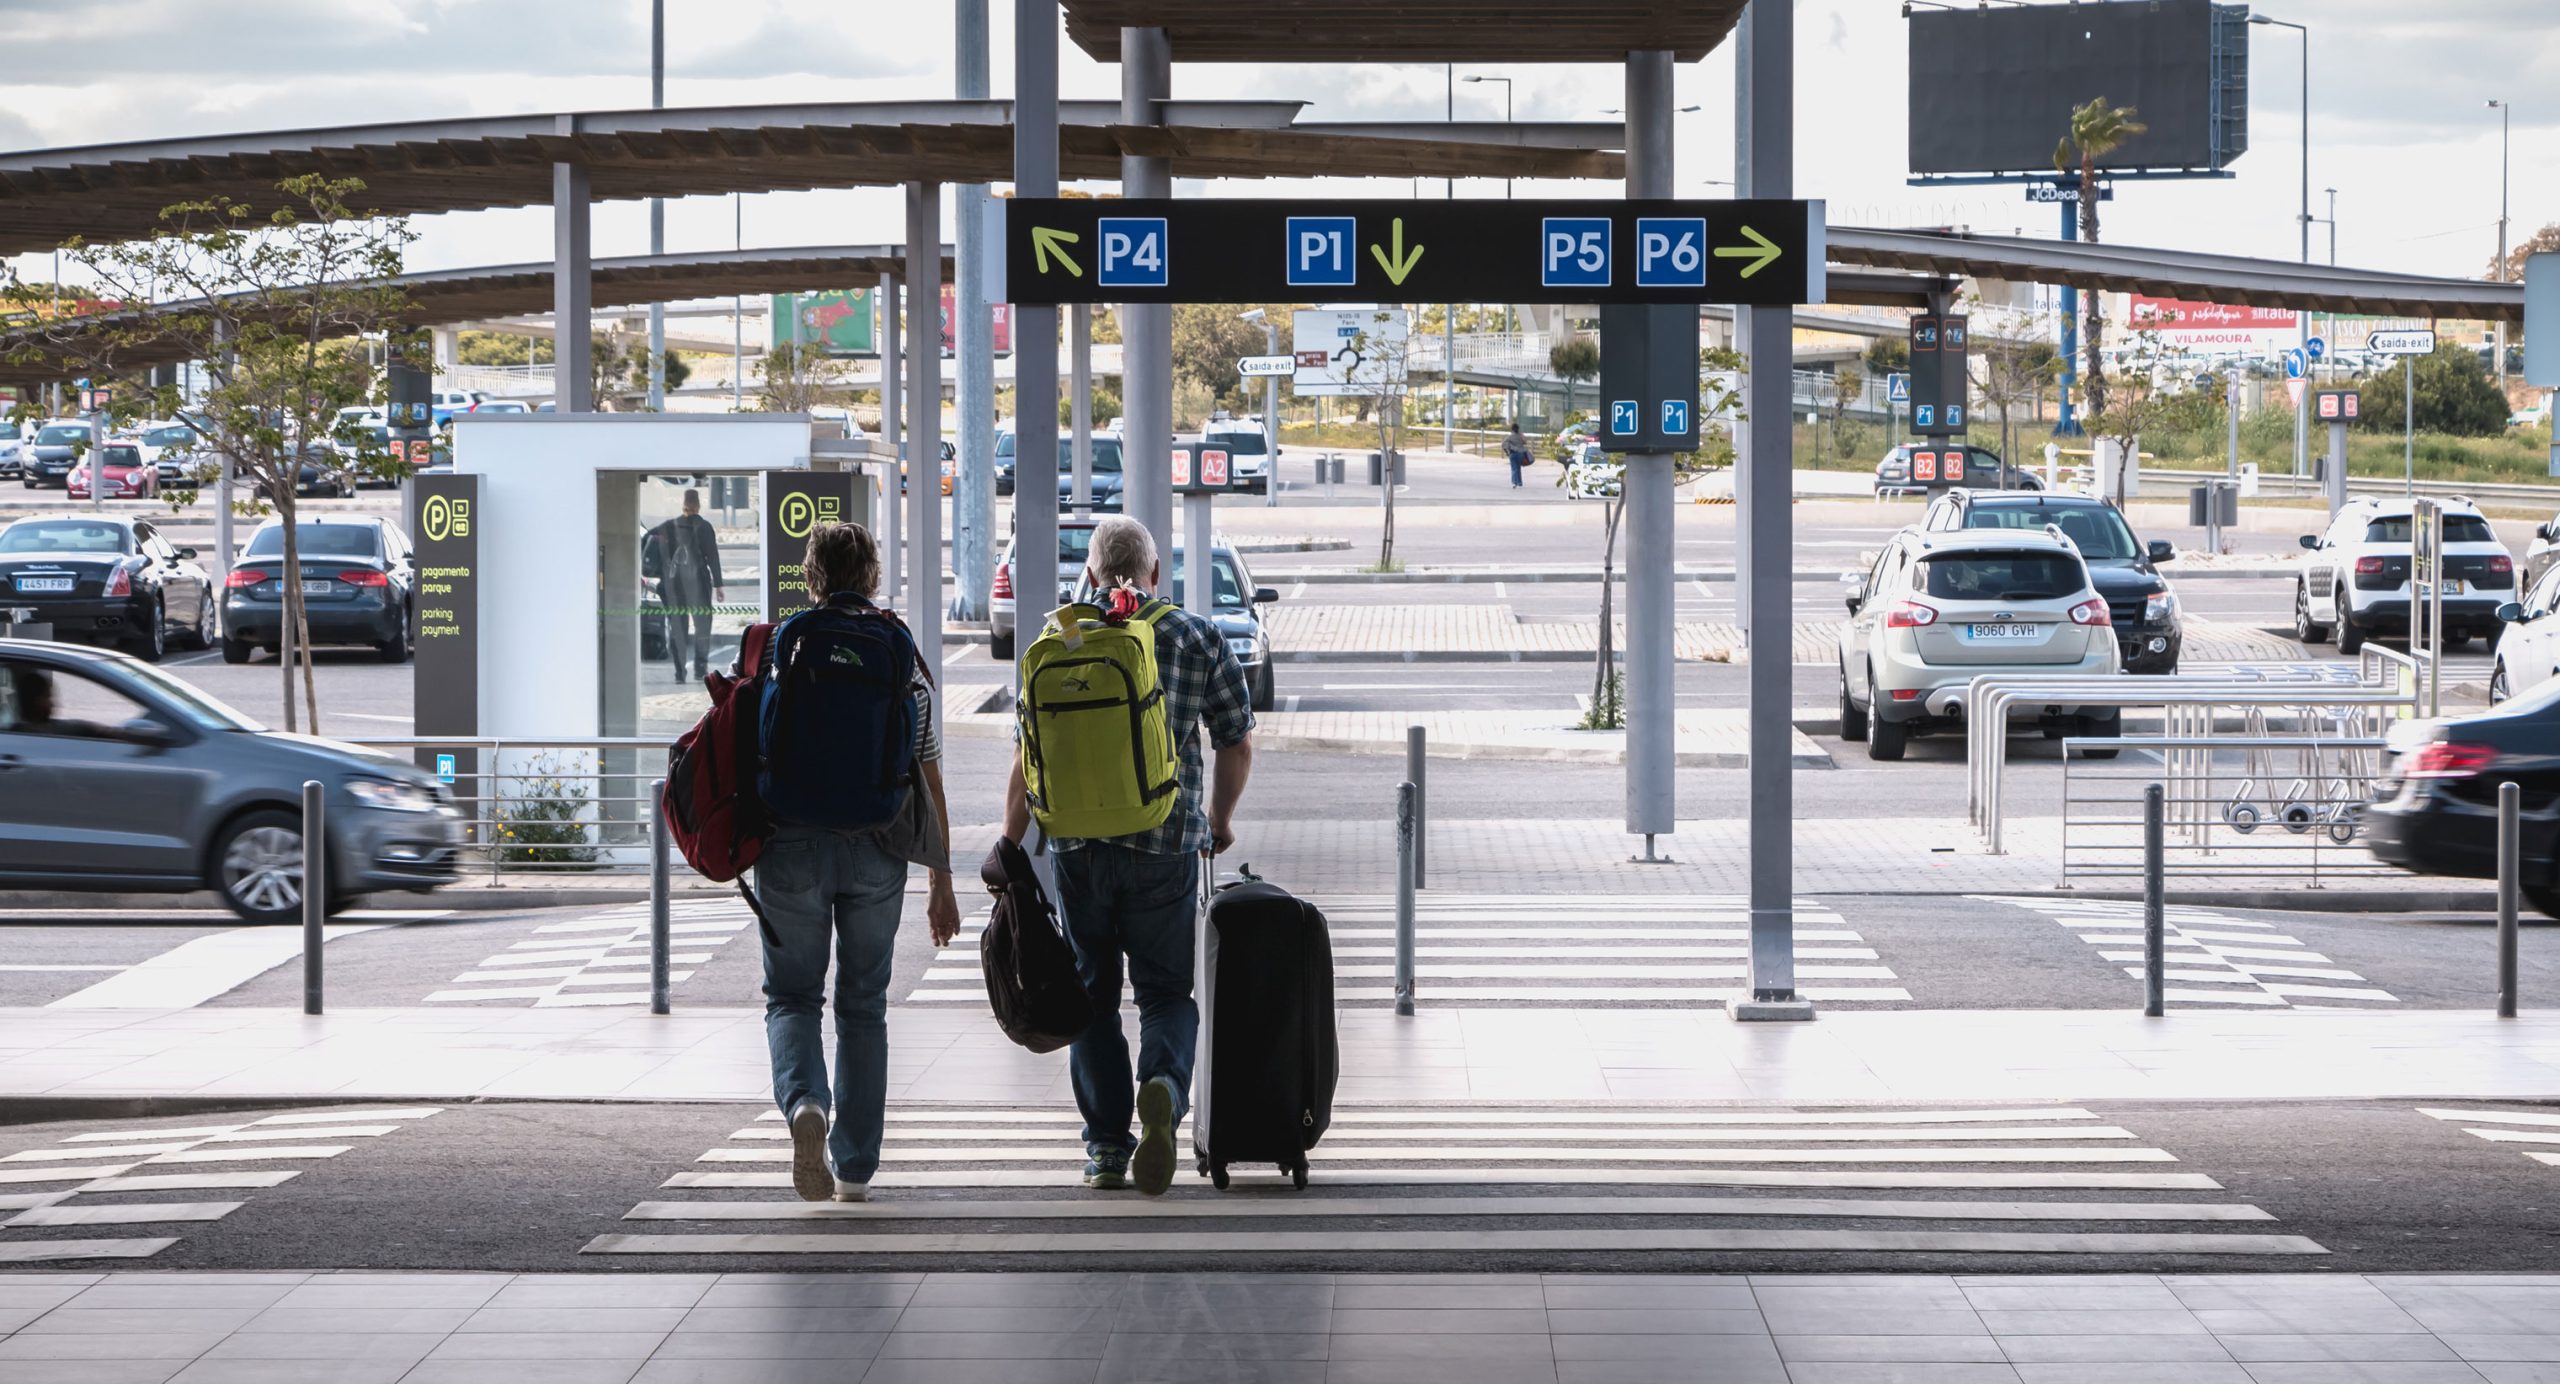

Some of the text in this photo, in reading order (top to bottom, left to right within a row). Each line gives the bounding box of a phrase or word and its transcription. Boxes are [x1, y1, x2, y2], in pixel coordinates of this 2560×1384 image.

[1105, 233, 1160, 271] P4
[1301, 232, 1341, 270] P1
[1549, 232, 1604, 272] P5
[1643, 232, 1699, 272] P6
[2175, 334, 2252, 344] VILAMOURA
[1615, 405, 1634, 430] P1
[1665, 404, 1684, 430] P1
[1919, 408, 1931, 423] P1
[1948, 408, 1959, 423] P1
[1204, 458, 1225, 477] A2
[1917, 459, 1933, 474] B2
[1946, 460, 1961, 474] B2
[422, 566, 469, 579] pagamento
[422, 583, 452, 595] parque
[422, 608, 453, 621] parking
[422, 625, 460, 638] payment
[1975, 625, 2035, 637] 9060 GVH
